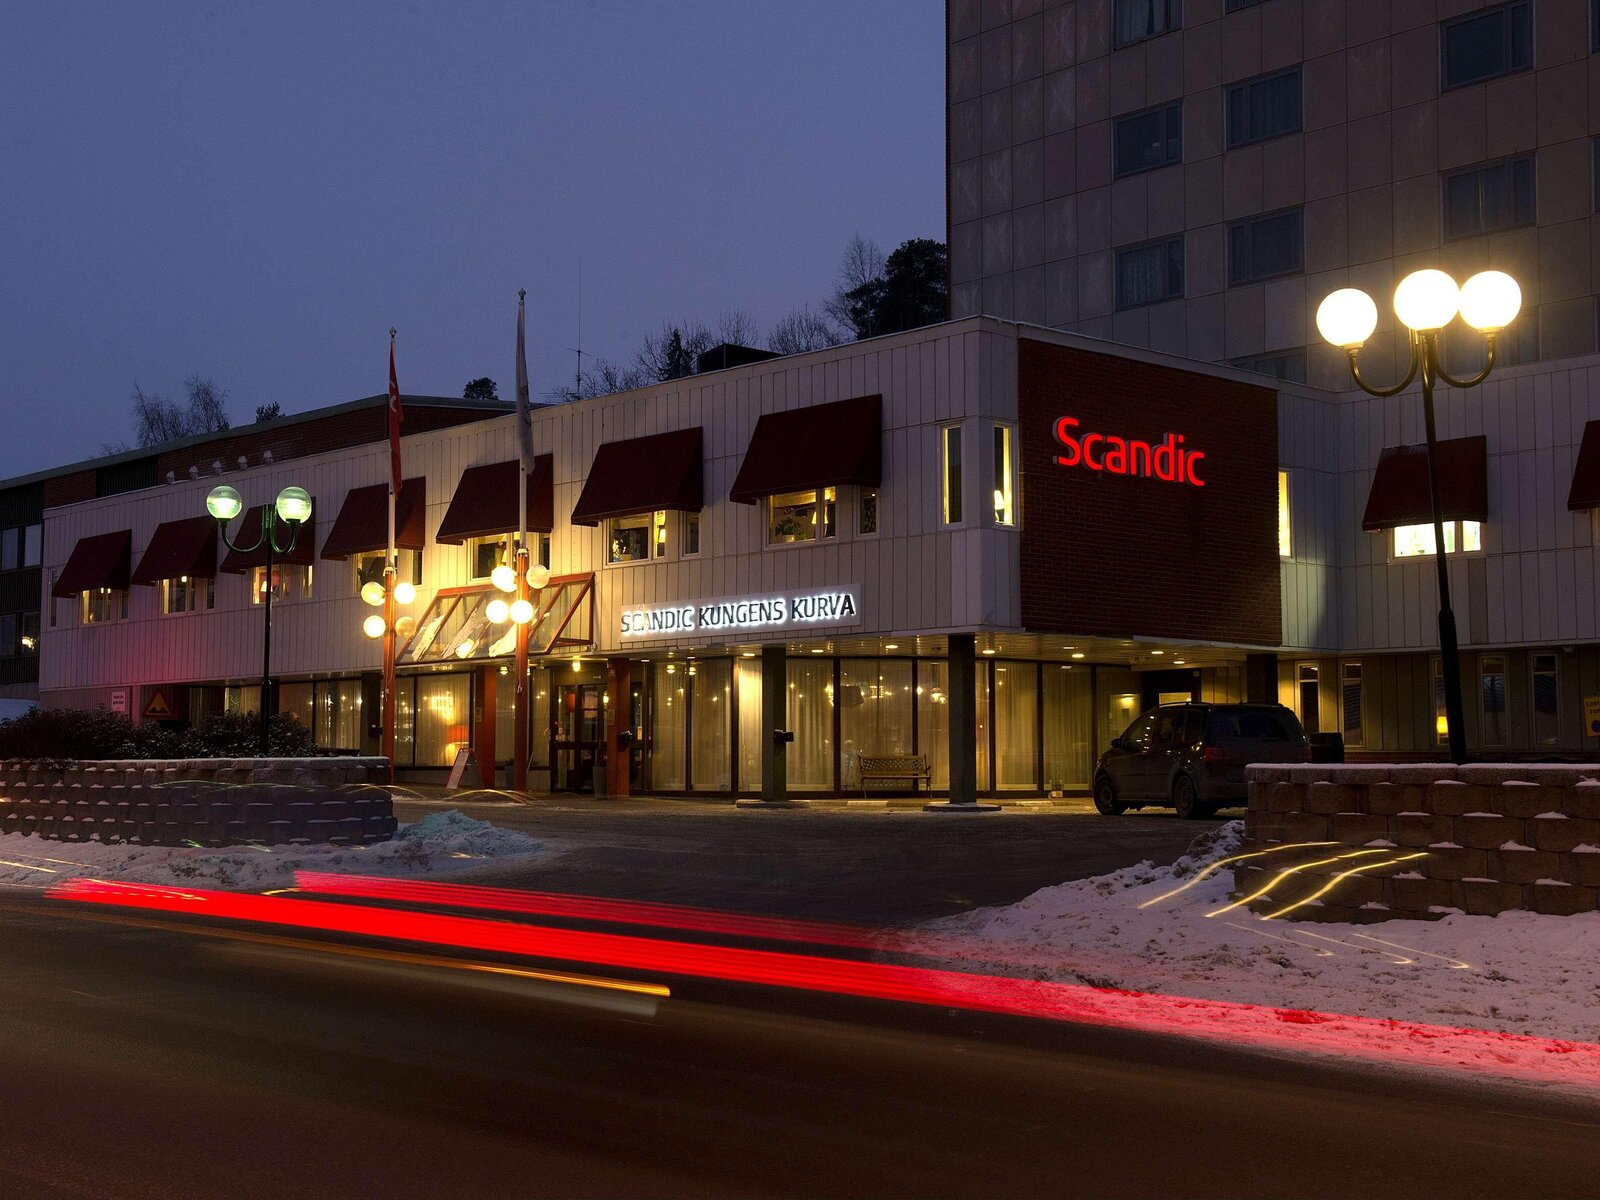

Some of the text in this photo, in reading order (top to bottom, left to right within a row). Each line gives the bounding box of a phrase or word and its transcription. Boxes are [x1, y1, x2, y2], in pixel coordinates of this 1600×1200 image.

[1053, 416, 1205, 486] Scandic
[620, 594, 855, 633] SCANDIC KUNGENS KURVA
